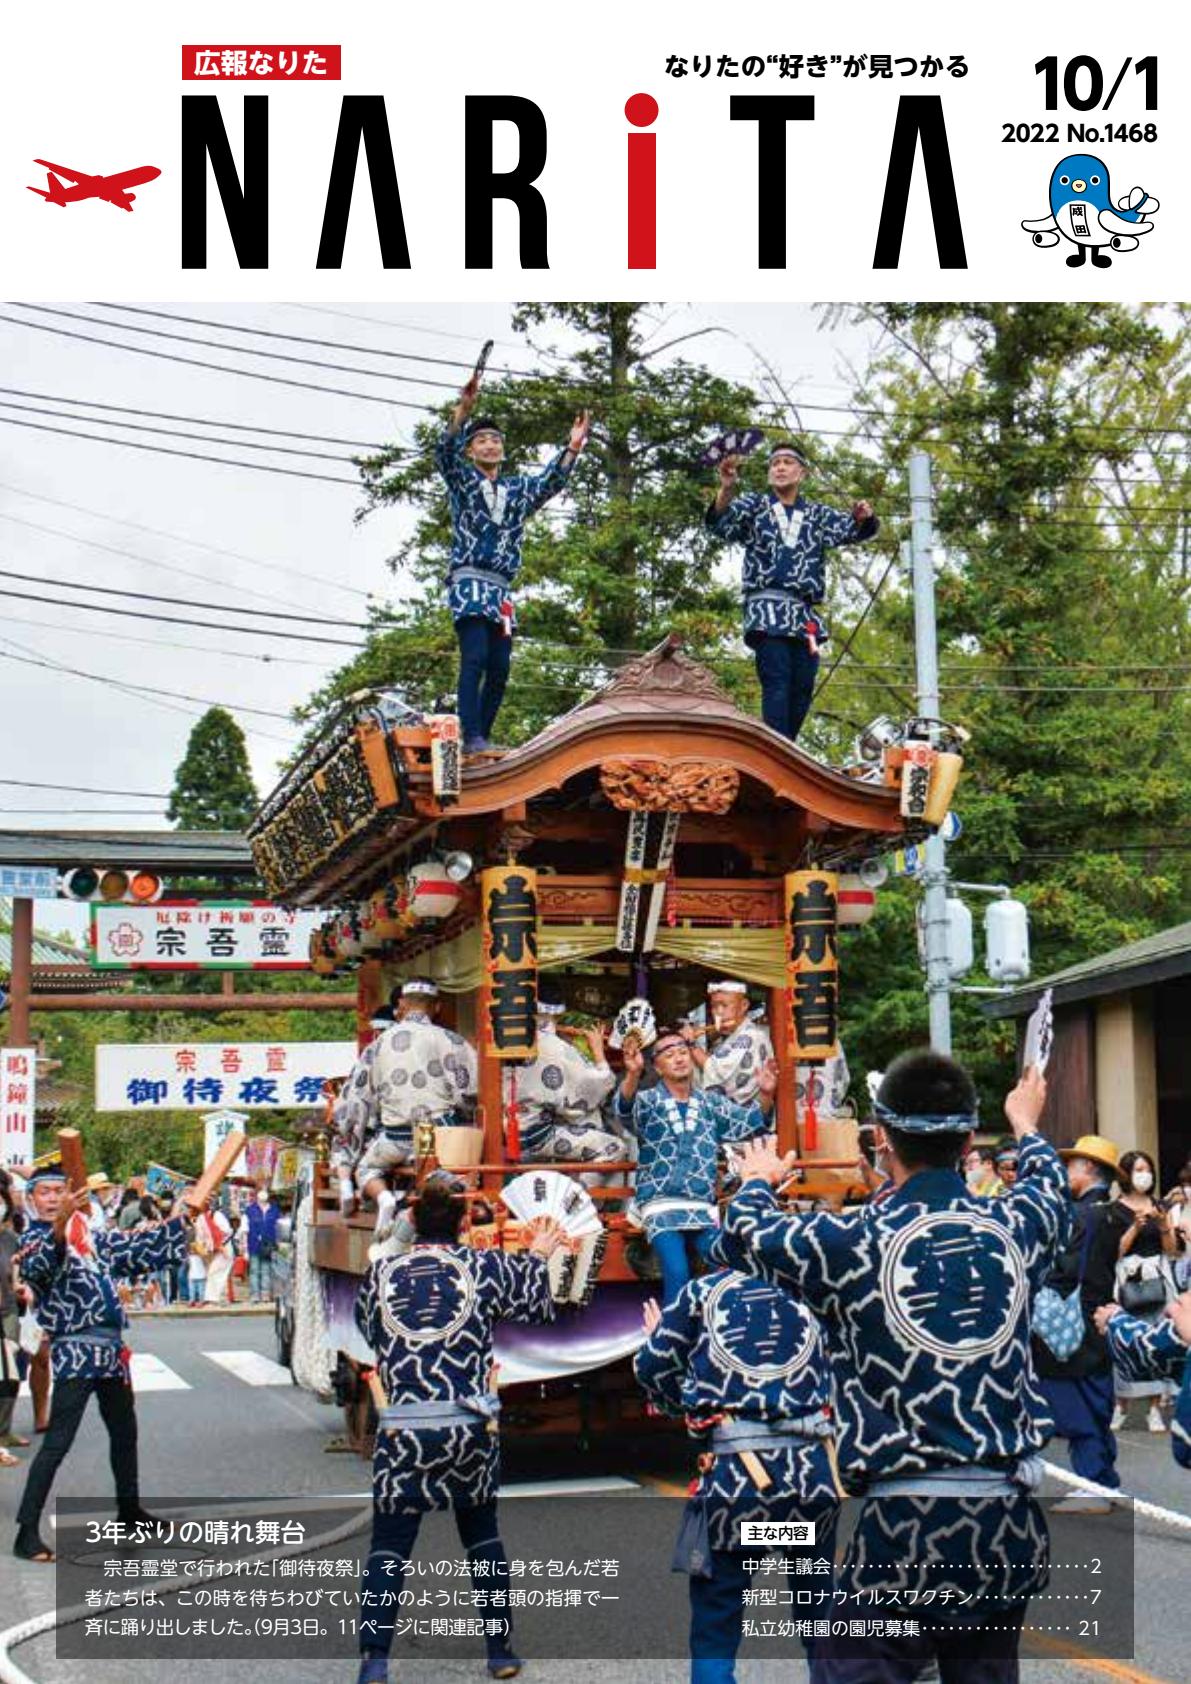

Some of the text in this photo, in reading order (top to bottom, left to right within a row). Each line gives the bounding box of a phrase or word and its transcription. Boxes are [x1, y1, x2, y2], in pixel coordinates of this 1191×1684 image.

[156, 926, 291, 957] 宗吾霊
[175, 1047, 288, 1074] 宗吾霊
[126, 1076, 326, 1106] 御待夜祭
